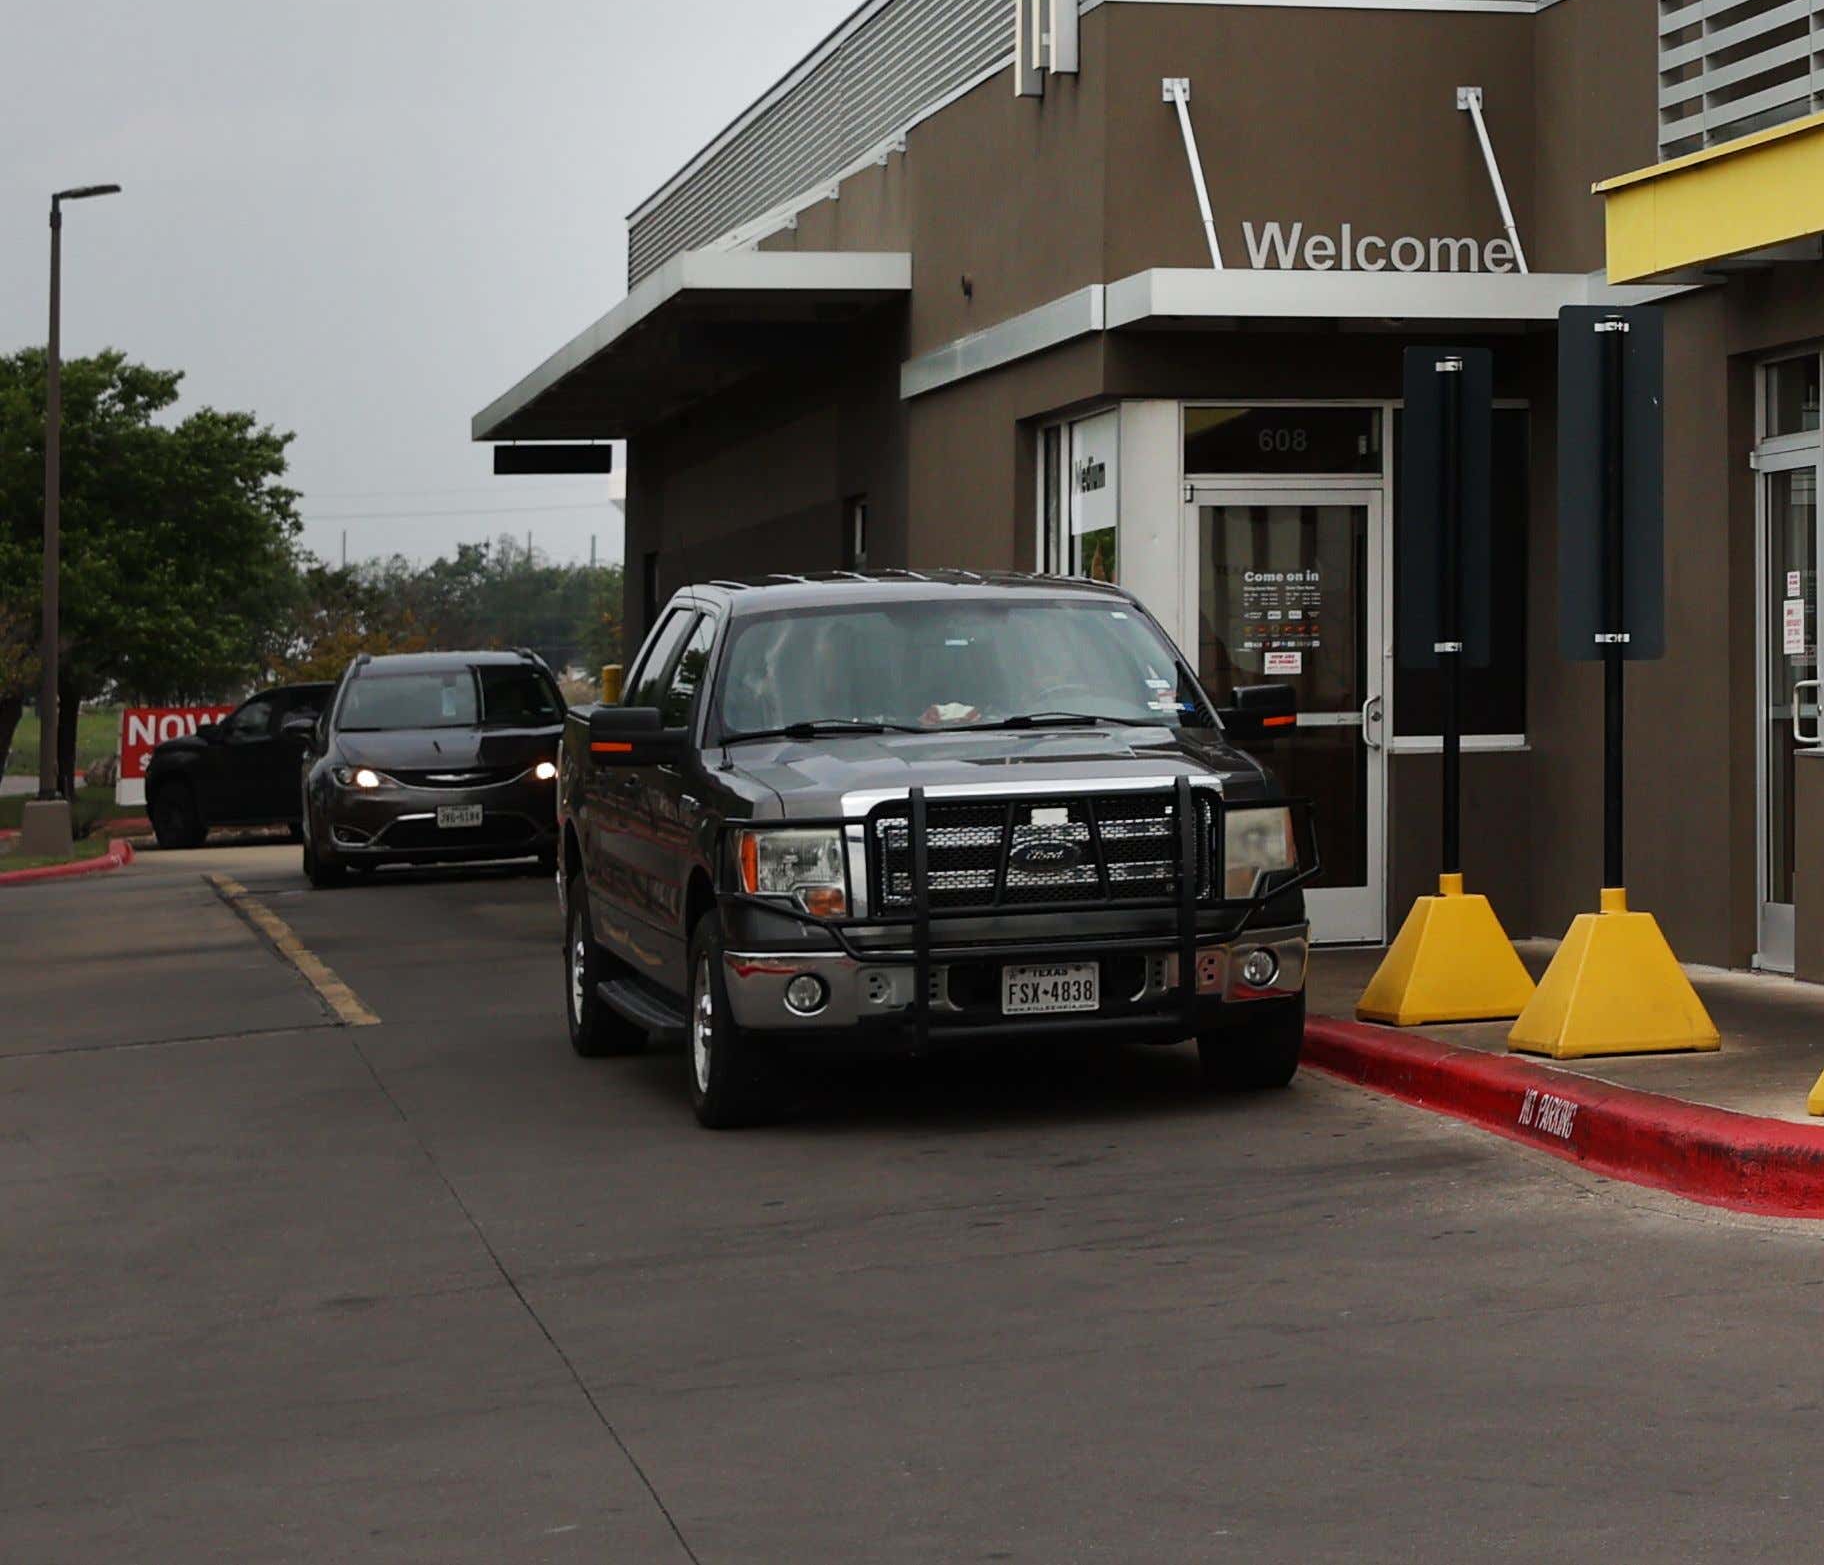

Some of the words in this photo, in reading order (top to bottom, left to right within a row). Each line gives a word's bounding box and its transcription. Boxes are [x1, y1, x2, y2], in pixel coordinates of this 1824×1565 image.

[1242, 221, 1515, 274] Welcome
[1258, 429, 1309, 452] 608
[1244, 571, 1284, 583] Come
[1286, 572, 1304, 582] on
[1306, 569, 1320, 582] in
[1033, 967, 1068, 977] TEXAS
[1518, 1088, 1539, 1125] NO
[1534, 1093, 1578, 1139] PARKING
